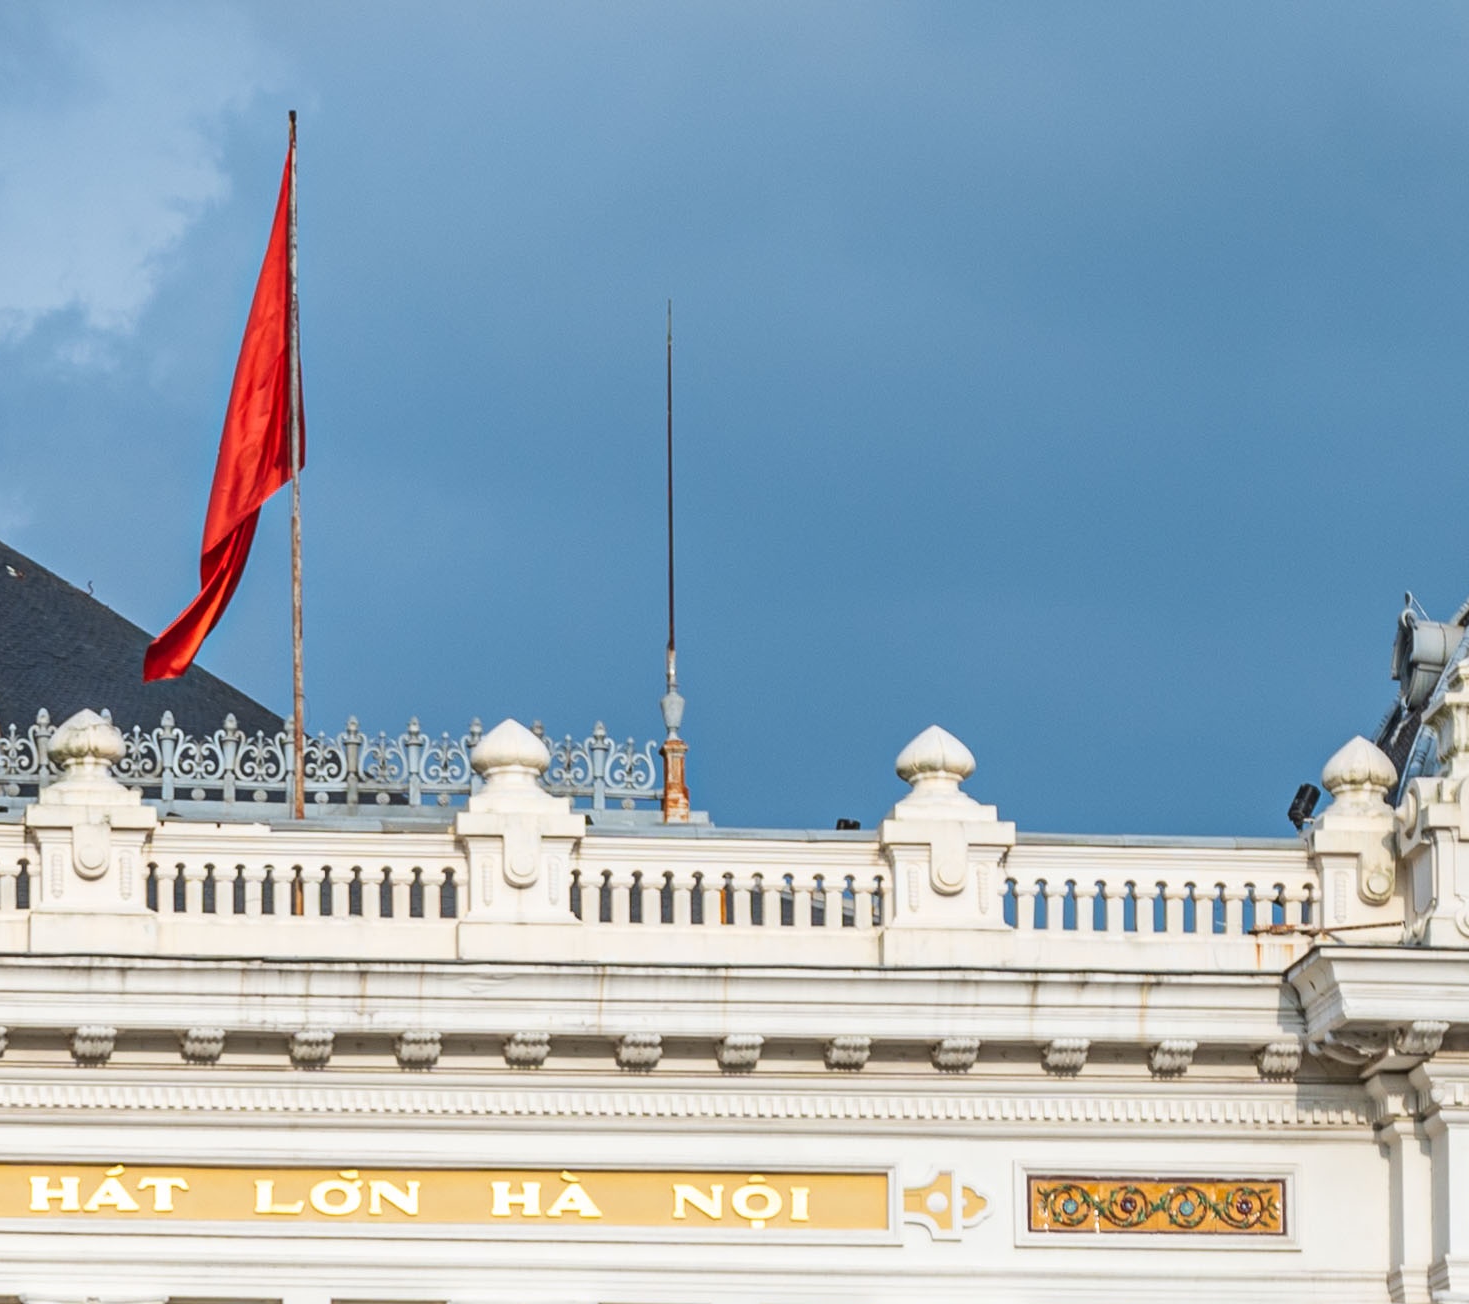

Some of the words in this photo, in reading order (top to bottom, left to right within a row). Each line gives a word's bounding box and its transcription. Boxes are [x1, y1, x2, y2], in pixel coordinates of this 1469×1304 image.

[28, 1164, 190, 1212] HÁT
[253, 1169, 421, 1217] LỚN
[490, 1170, 603, 1218] HÀ
[672, 1173, 810, 1229] NỘI
